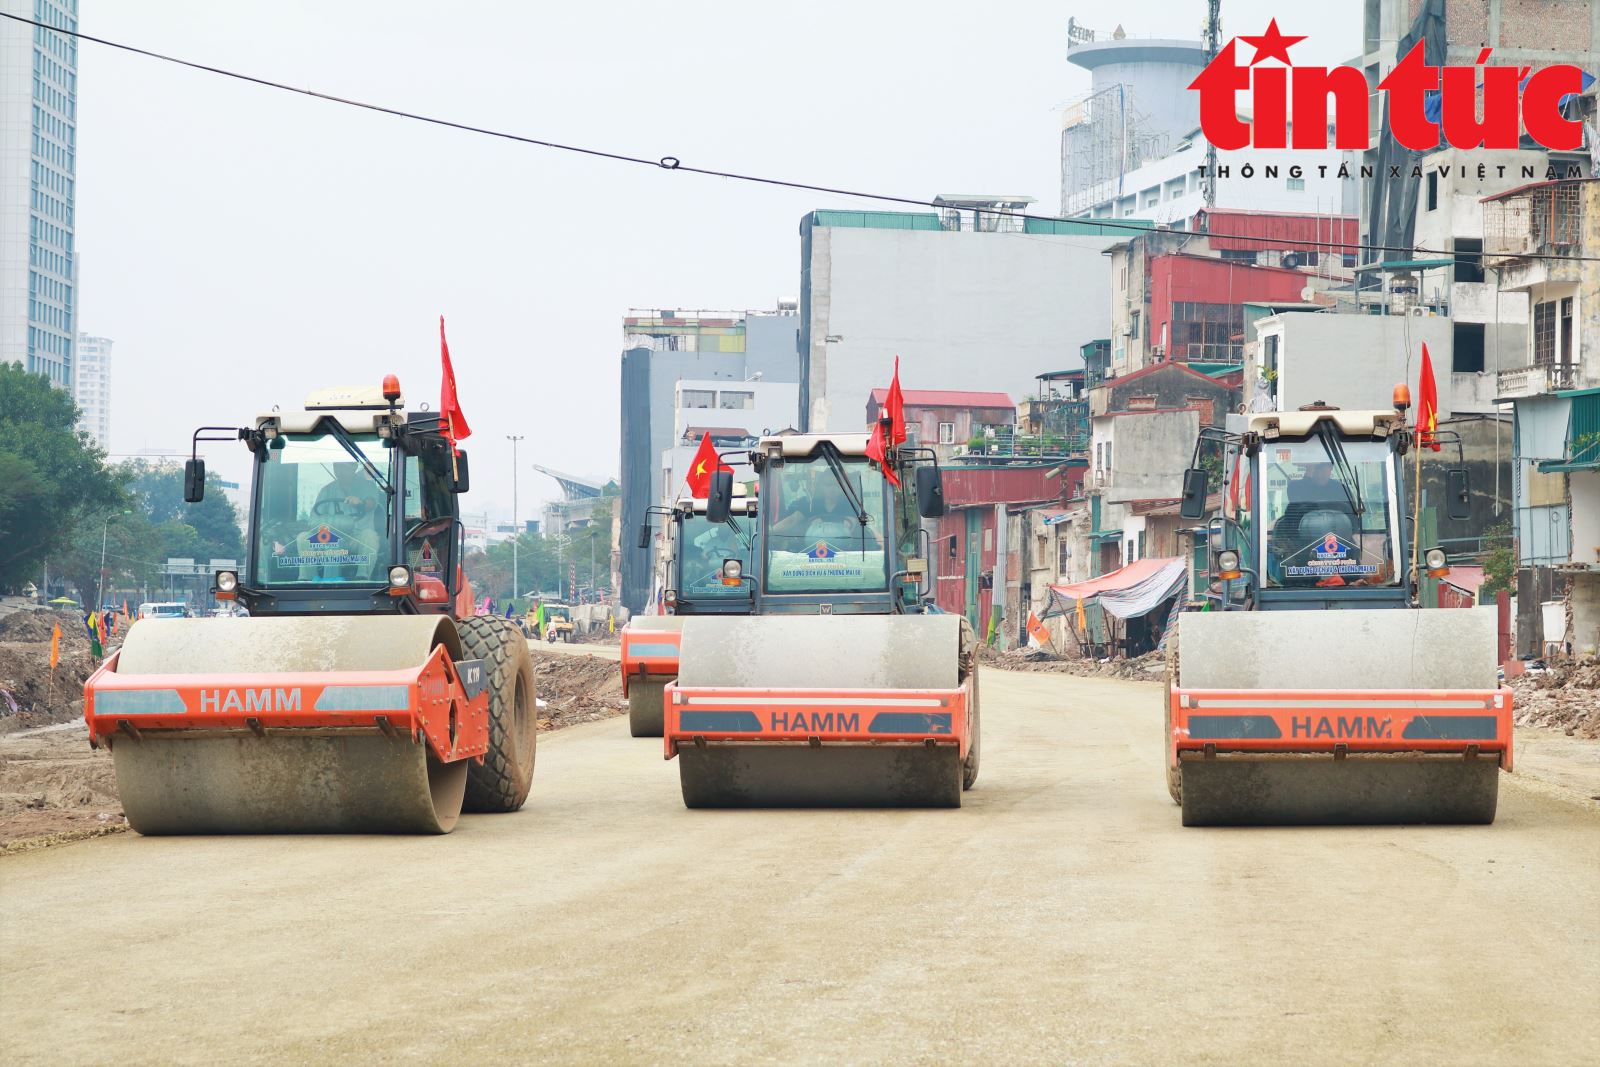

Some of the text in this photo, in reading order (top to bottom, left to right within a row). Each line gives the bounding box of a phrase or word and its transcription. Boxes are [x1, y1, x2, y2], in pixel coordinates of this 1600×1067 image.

[200, 687, 302, 713] HAMM
[771, 711, 860, 733] HAMM
[1291, 715, 1392, 739] HAMM
